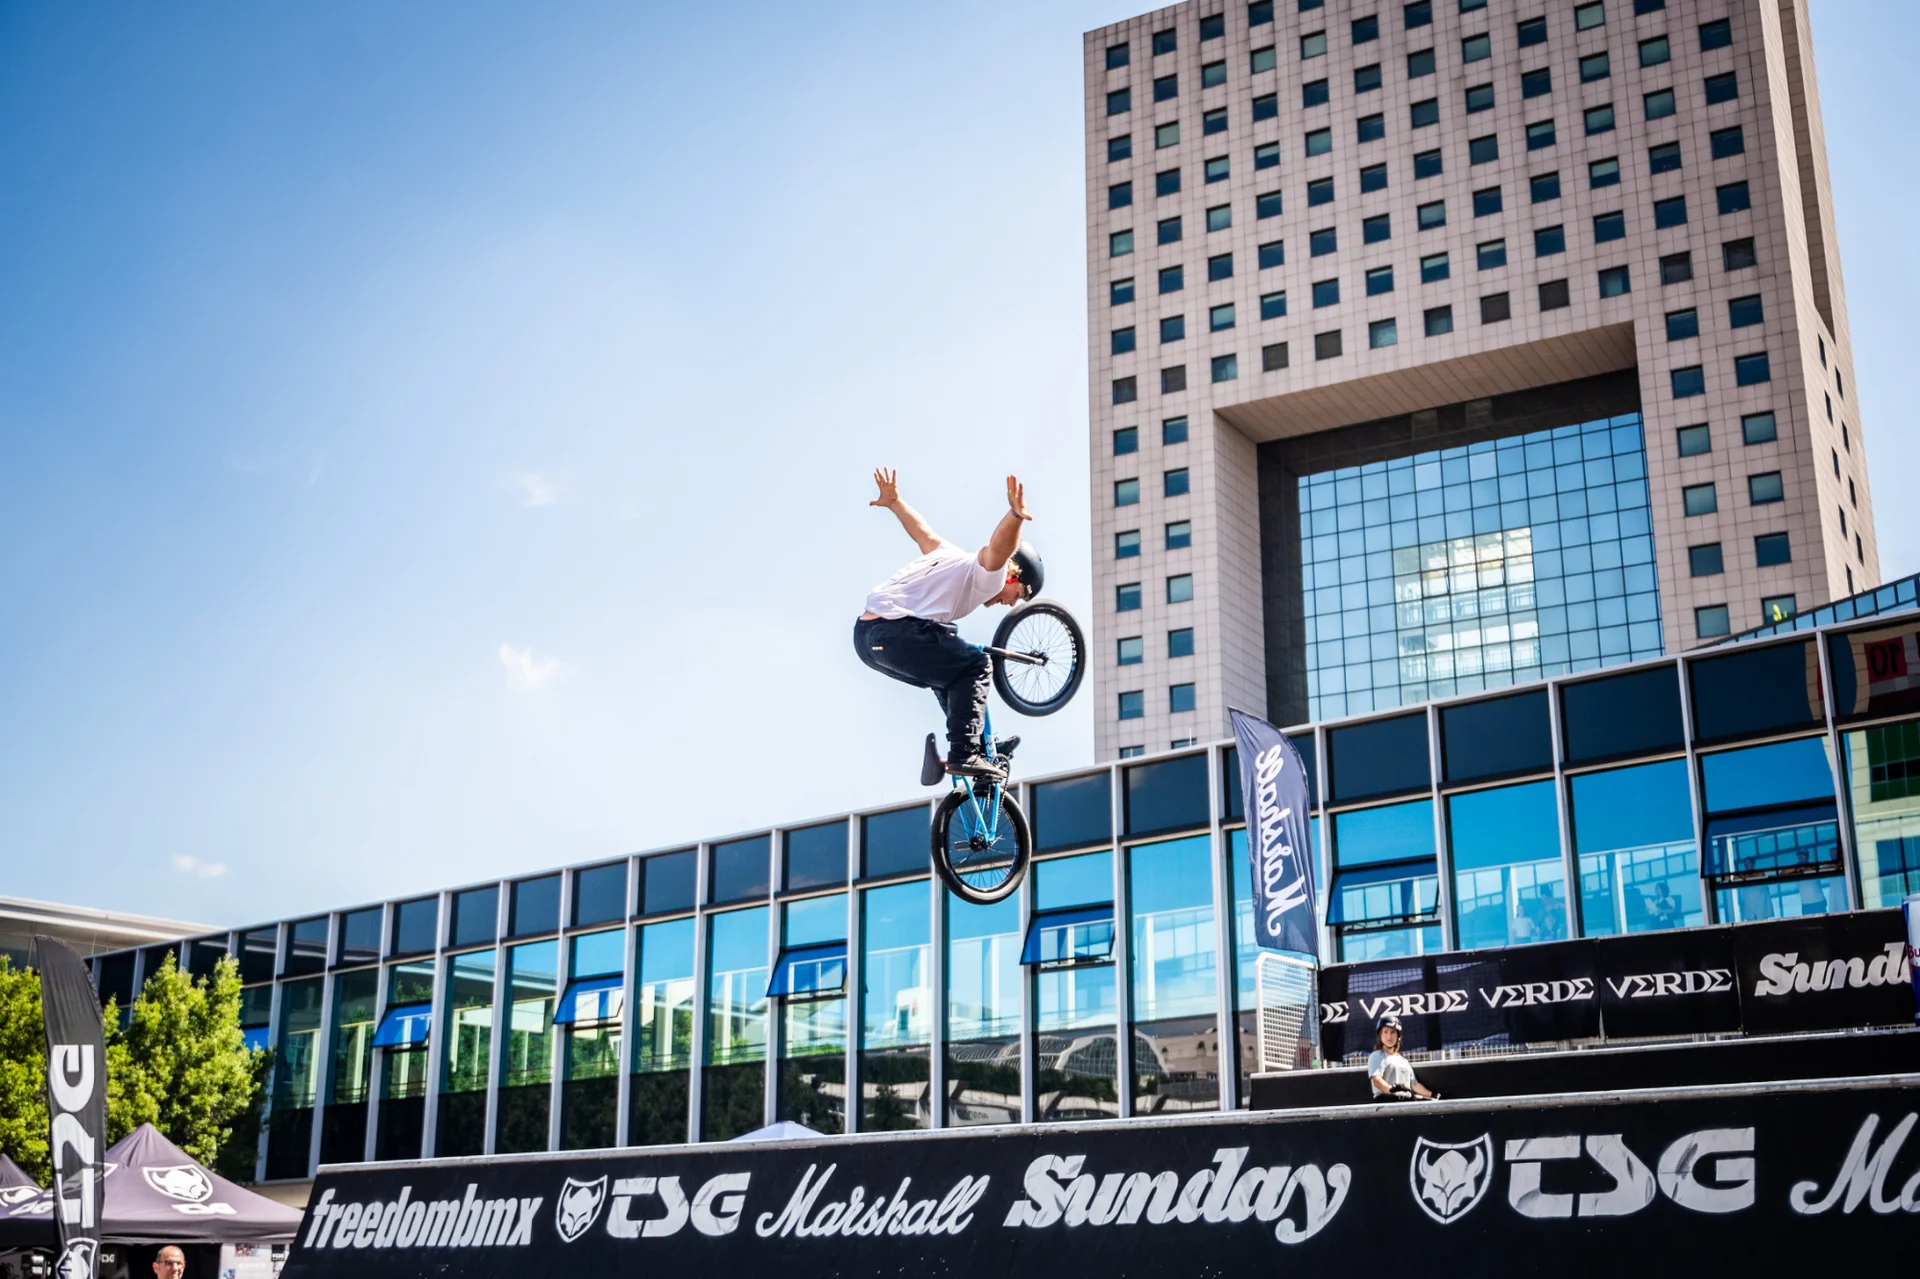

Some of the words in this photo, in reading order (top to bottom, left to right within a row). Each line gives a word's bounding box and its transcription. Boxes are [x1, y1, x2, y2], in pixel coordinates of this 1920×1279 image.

[302, 1183, 544, 1249] freedombmx
[605, 1172, 752, 1239] TSG
[755, 1162, 991, 1238] Marshall
[1002, 1146, 1352, 1245] Sunday
[1504, 1126, 1756, 1219] TSG
